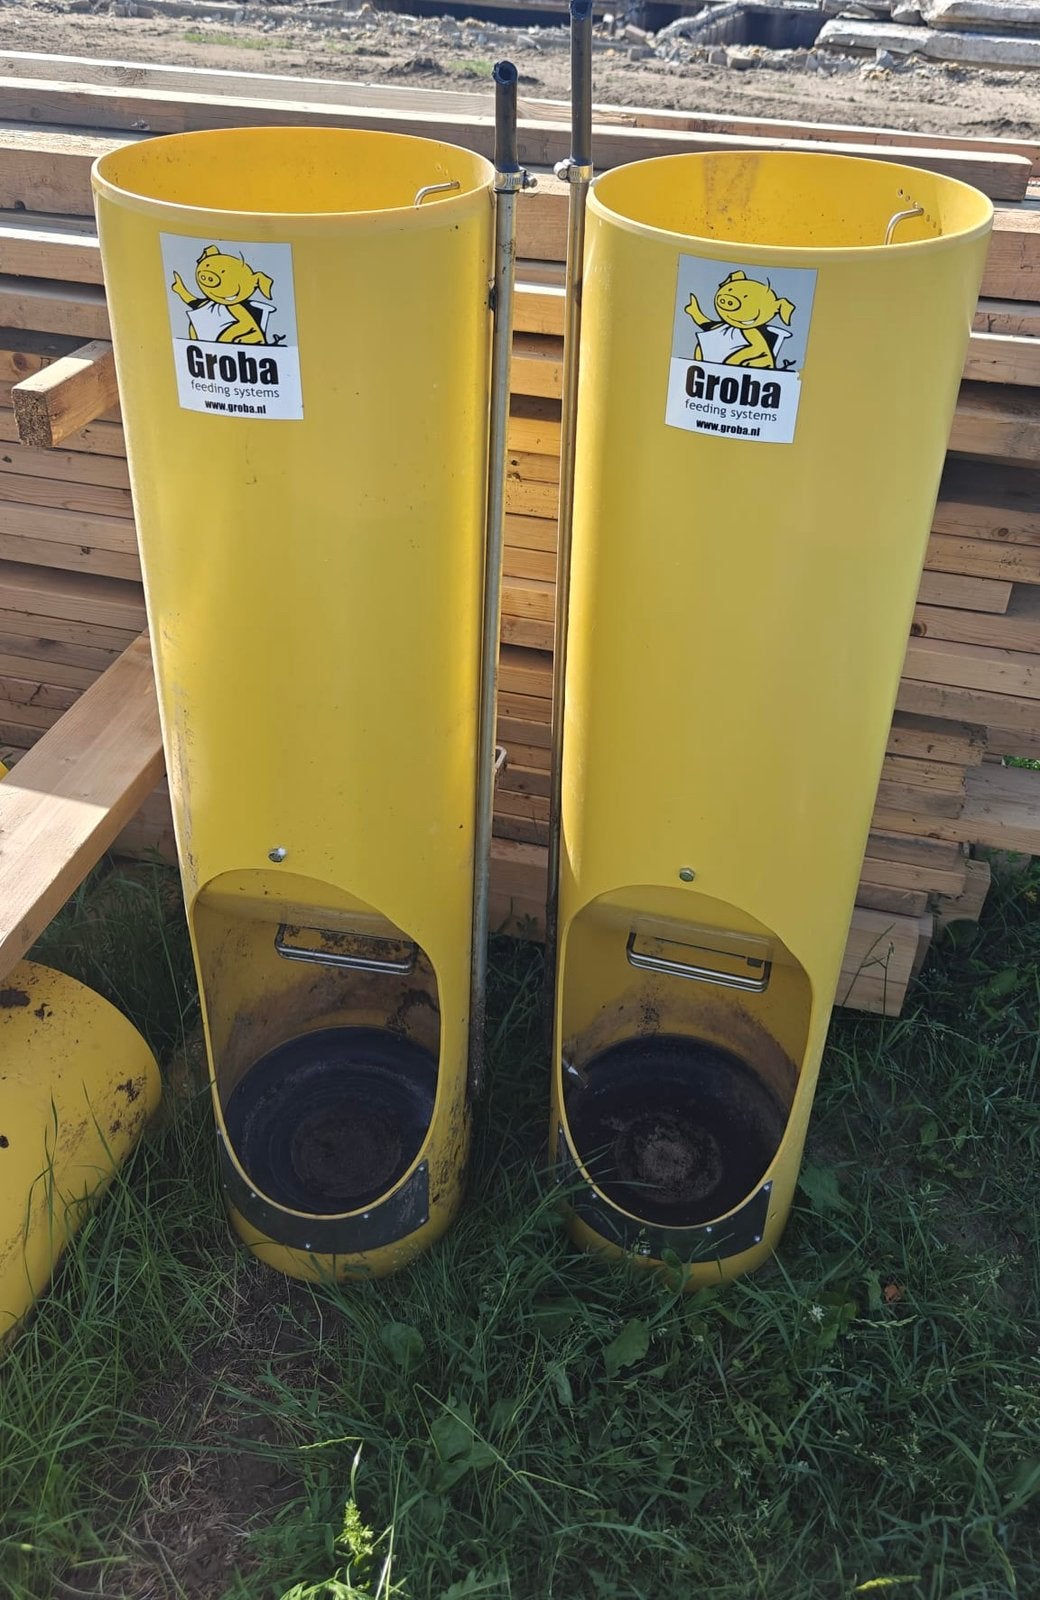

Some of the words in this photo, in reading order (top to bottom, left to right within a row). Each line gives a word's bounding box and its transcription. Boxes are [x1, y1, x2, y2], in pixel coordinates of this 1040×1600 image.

[186, 345, 279, 385] Groba
[191, 379, 230, 398] feeding
[234, 386, 280, 398] systems
[685, 365, 782, 409] Groba
[205, 400, 267, 414] www.groba.nl
[685, 399, 727, 419] feeding
[730, 409, 777, 422] systems
[695, 419, 761, 437] www.groba.nl
